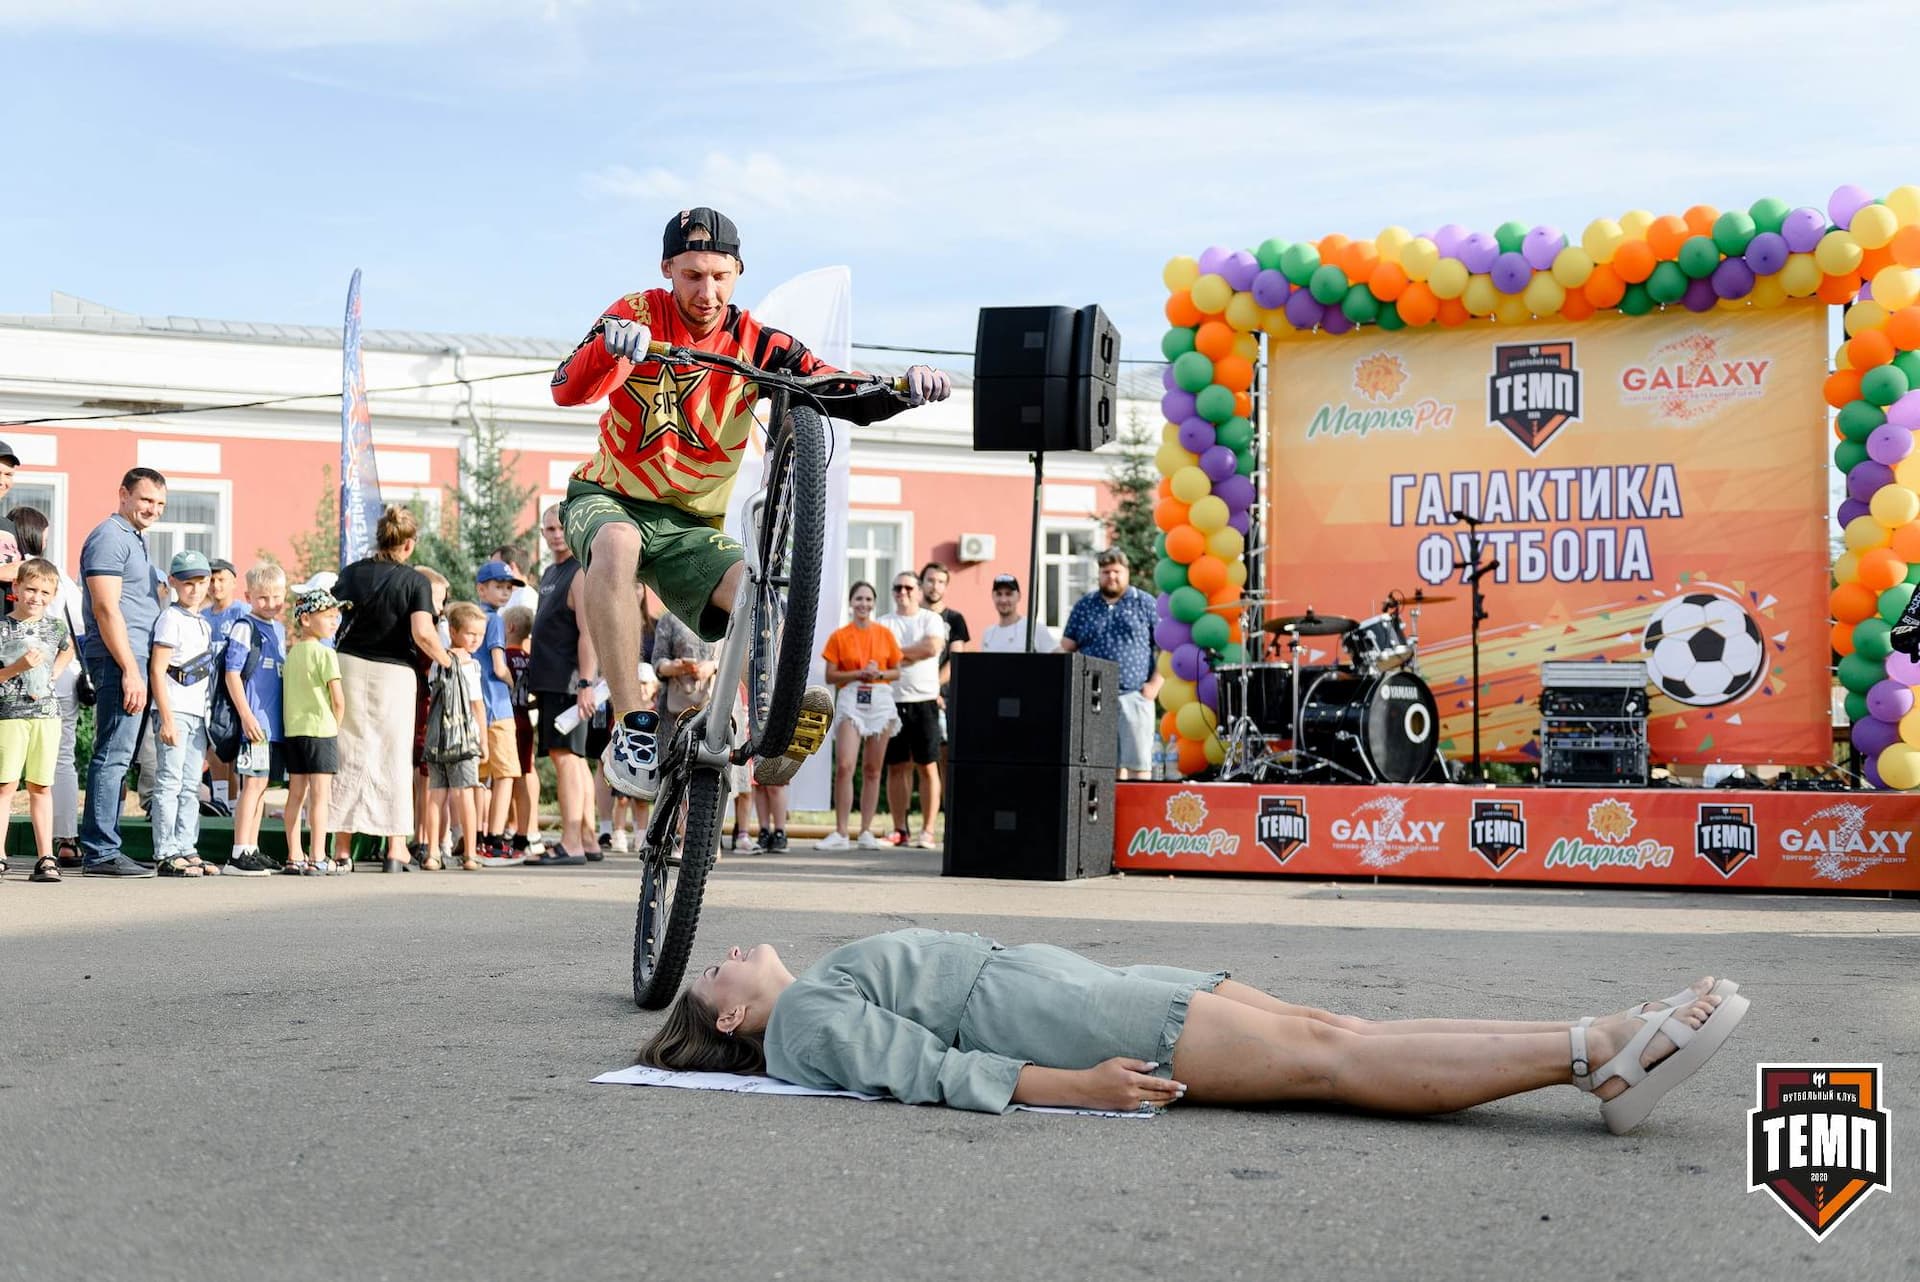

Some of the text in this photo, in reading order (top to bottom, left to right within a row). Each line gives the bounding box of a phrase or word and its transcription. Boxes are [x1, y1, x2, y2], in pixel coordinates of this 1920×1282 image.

[1622, 360, 1769, 391] GALAXY
[1495, 372, 1574, 414] ТЕМП
[1390, 464, 1683, 526] ГАЛАКТИКА
[1417, 526, 1653, 585] ФУТБОЛА
[1390, 686, 1418, 699] YAMAHA
[1261, 815, 1304, 840] ТЕМП
[1331, 819, 1445, 843] GALAXY
[1474, 820, 1522, 846] ТЕМП
[1701, 824, 1751, 850] ТЕМП
[1780, 829, 1912, 853] GALAXY
